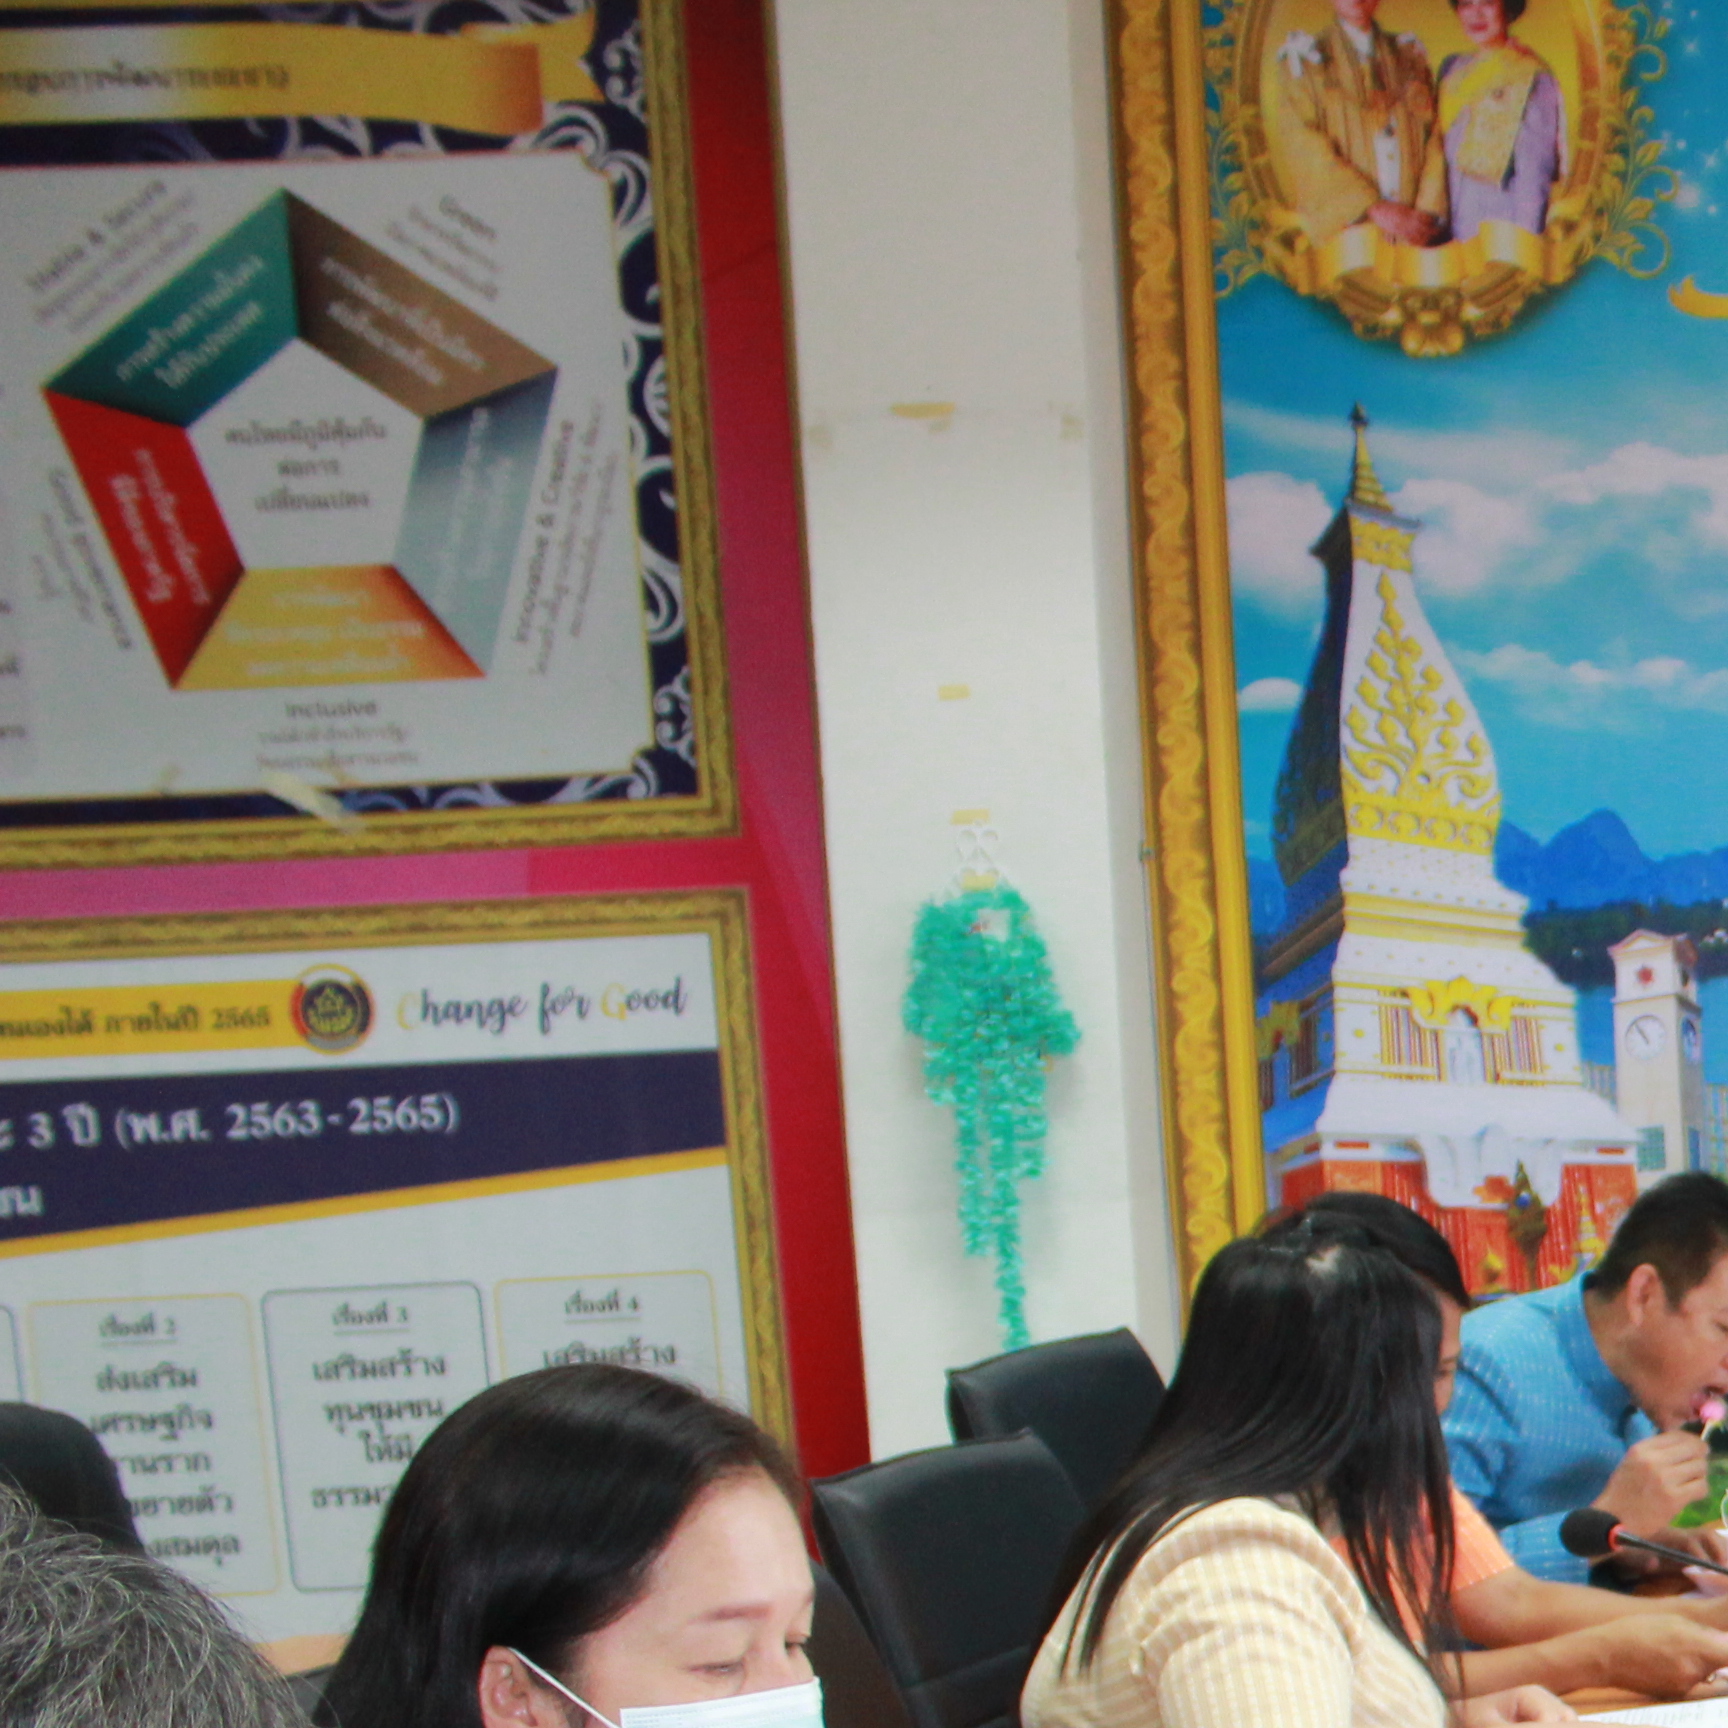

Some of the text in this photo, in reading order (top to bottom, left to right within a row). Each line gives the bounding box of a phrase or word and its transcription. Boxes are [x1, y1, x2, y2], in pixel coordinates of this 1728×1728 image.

[213, 1004, 272, 1030] 2565
[396, 974, 692, 1036] Change for Good
[27, 1112, 54, 1149] 3
[61, 1101, 99, 1148] ปี
[96, 1360, 198, 1392] ส่งเสริม
[311, 1346, 447, 1382] เสริมสร้าง
[323, 1398, 445, 1438] ทุนชุมชน
[112, 1452, 212, 1475] านราก
